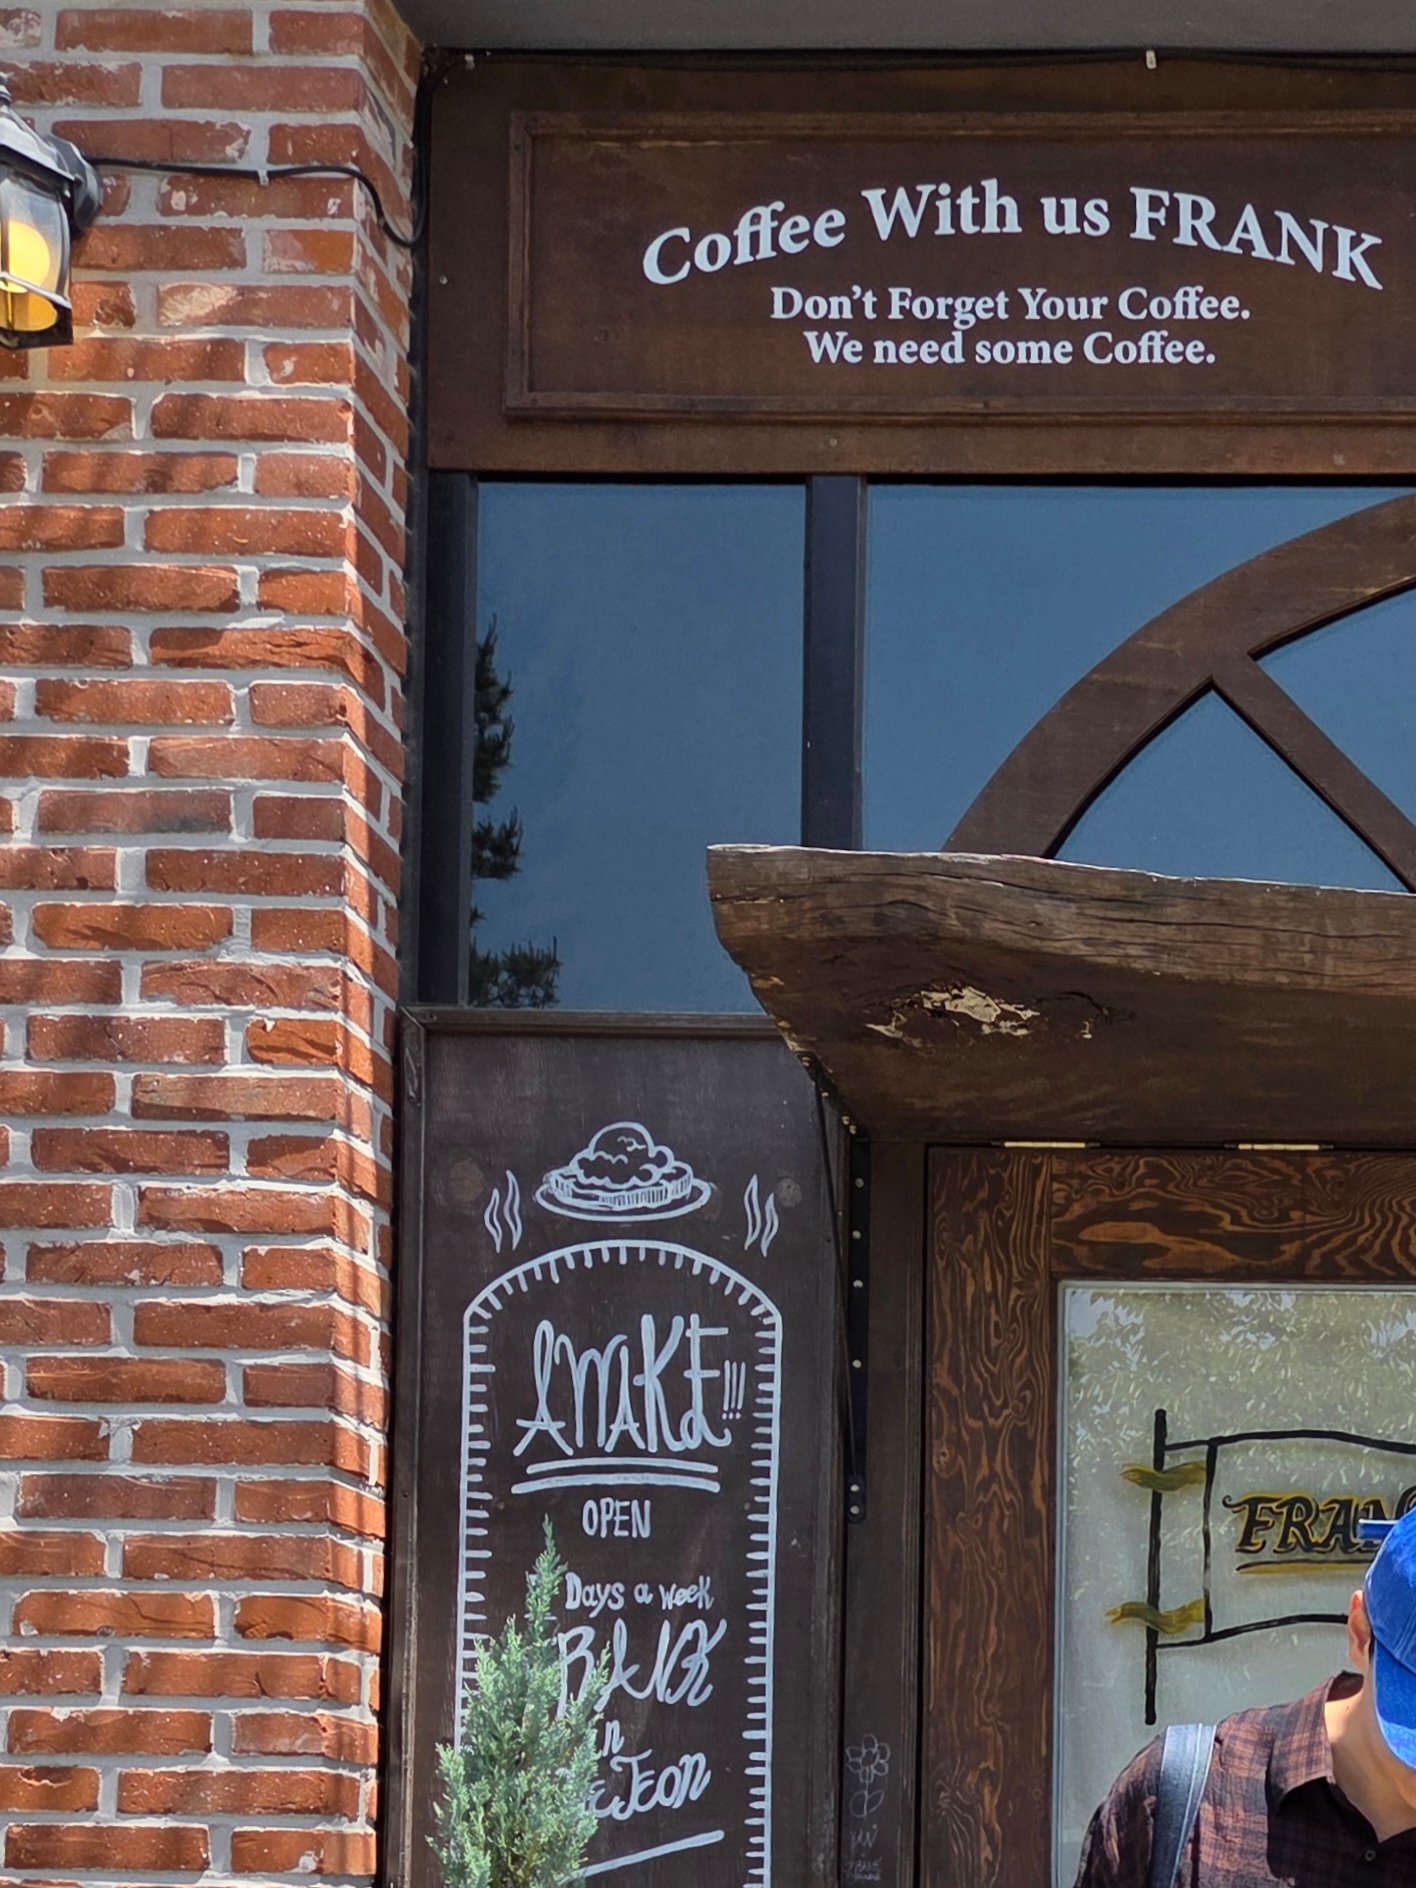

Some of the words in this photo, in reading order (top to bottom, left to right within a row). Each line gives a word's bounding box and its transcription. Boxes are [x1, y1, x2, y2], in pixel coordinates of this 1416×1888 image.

[642, 200, 846, 285] Coffee
[861, 178, 1023, 241] With
[1040, 197, 1110, 237] us
[1129, 186, 1383, 290] FRANK
[887, 287, 1010, 330] Forget
[1017, 287, 1109, 321] Your
[1118, 285, 1250, 320] Coffee.
[803, 331, 863, 364] We
[873, 330, 966, 364] need
[975, 340, 1073, 364] some
[1083, 329, 1216, 364] Coffee.
[582, 1497, 651, 1538] OPEN
[564, 1571, 625, 1619] Days
[633, 1583, 654, 1605] a
